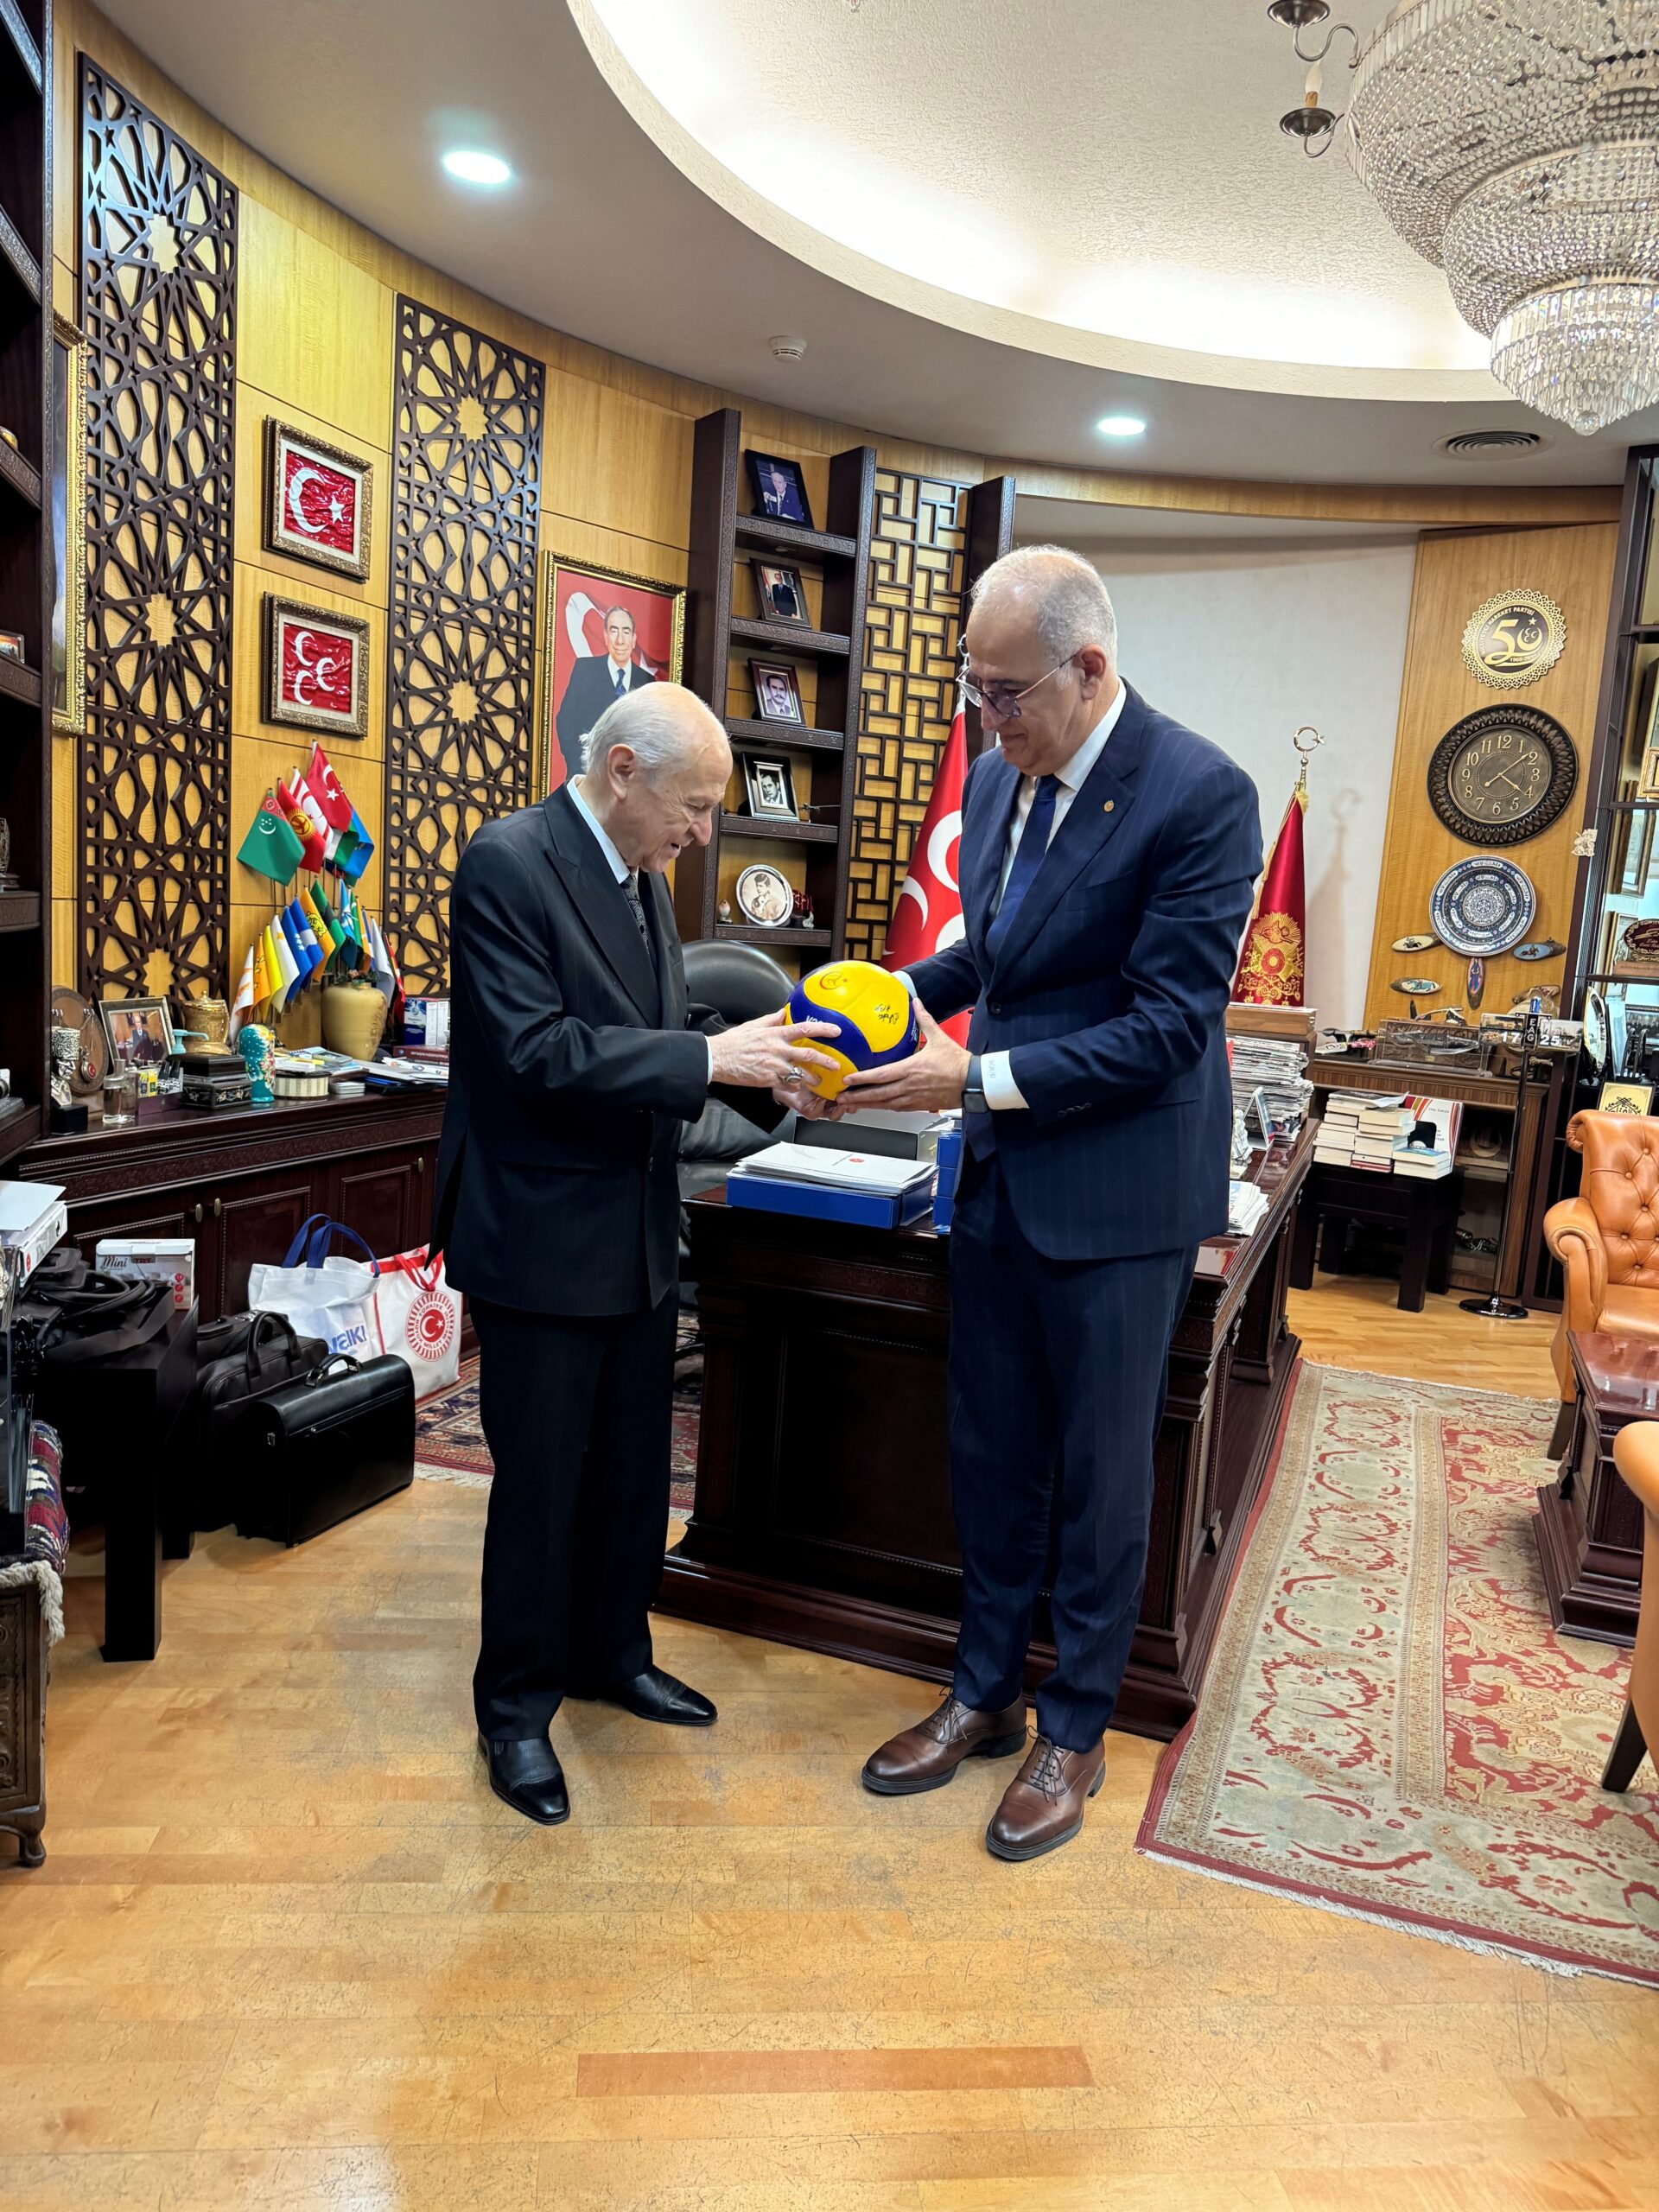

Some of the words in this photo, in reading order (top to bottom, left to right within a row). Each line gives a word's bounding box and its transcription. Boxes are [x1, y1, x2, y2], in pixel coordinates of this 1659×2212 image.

[1481, 740, 1491, 753] 11
[1497, 734, 1512, 749] 12
[1519, 740, 1523, 753] 1
[1465, 752, 1479, 766] 10
[1527, 751, 1538, 766] 2
[1461, 768, 1471, 782] 9
[1530, 768, 1540, 781] 3
[1465, 785, 1473, 798] 8
[1525, 785, 1534, 798] 4
[1476, 797, 1484, 810] 7
[1492, 801, 1502, 815] 6
[1510, 797, 1519, 810] 5
[1502, 1031, 1521, 1044] 17
[1540, 1035, 1560, 1046] 25
[100, 1255, 128, 1270] Mini
